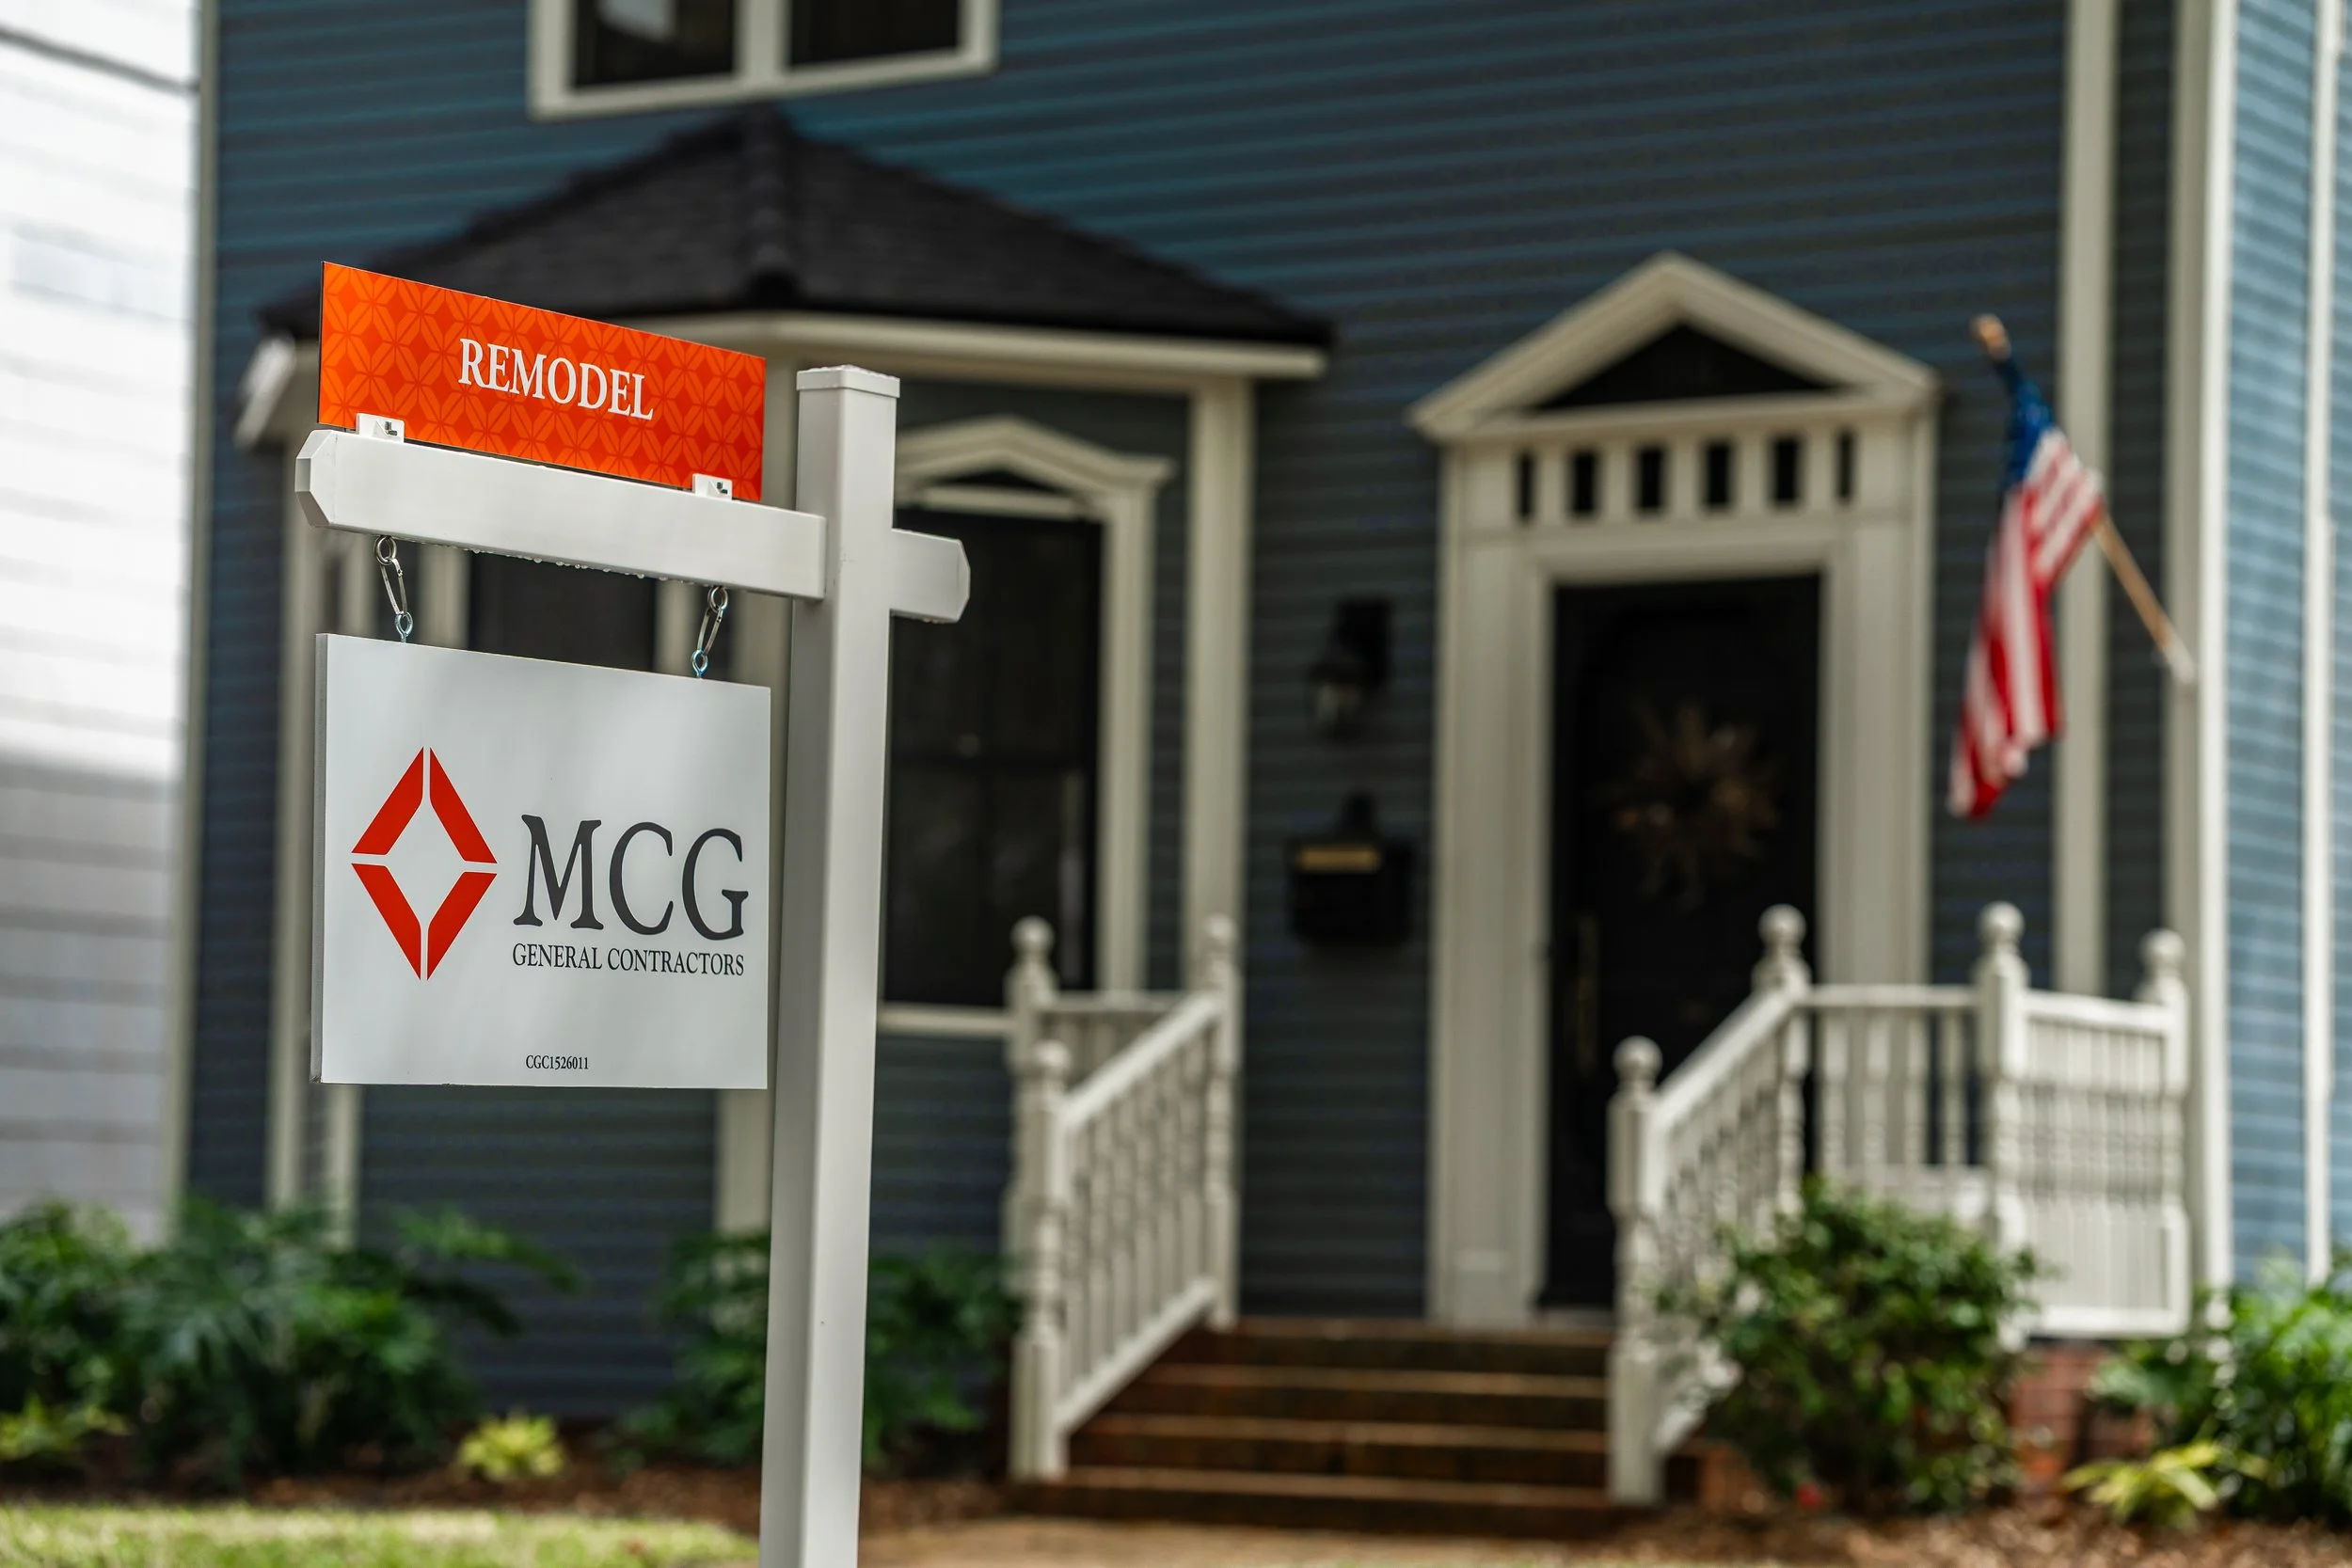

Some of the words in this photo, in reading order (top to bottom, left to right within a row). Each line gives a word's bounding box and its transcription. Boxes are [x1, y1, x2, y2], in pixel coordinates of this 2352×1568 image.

[458, 338, 654, 420] REMODEL
[513, 815, 749, 941] MCG
[513, 942, 602, 970] GENERAL
[608, 947, 744, 976] CONTRACTORS
[526, 1054, 589, 1070] CGC1526011
